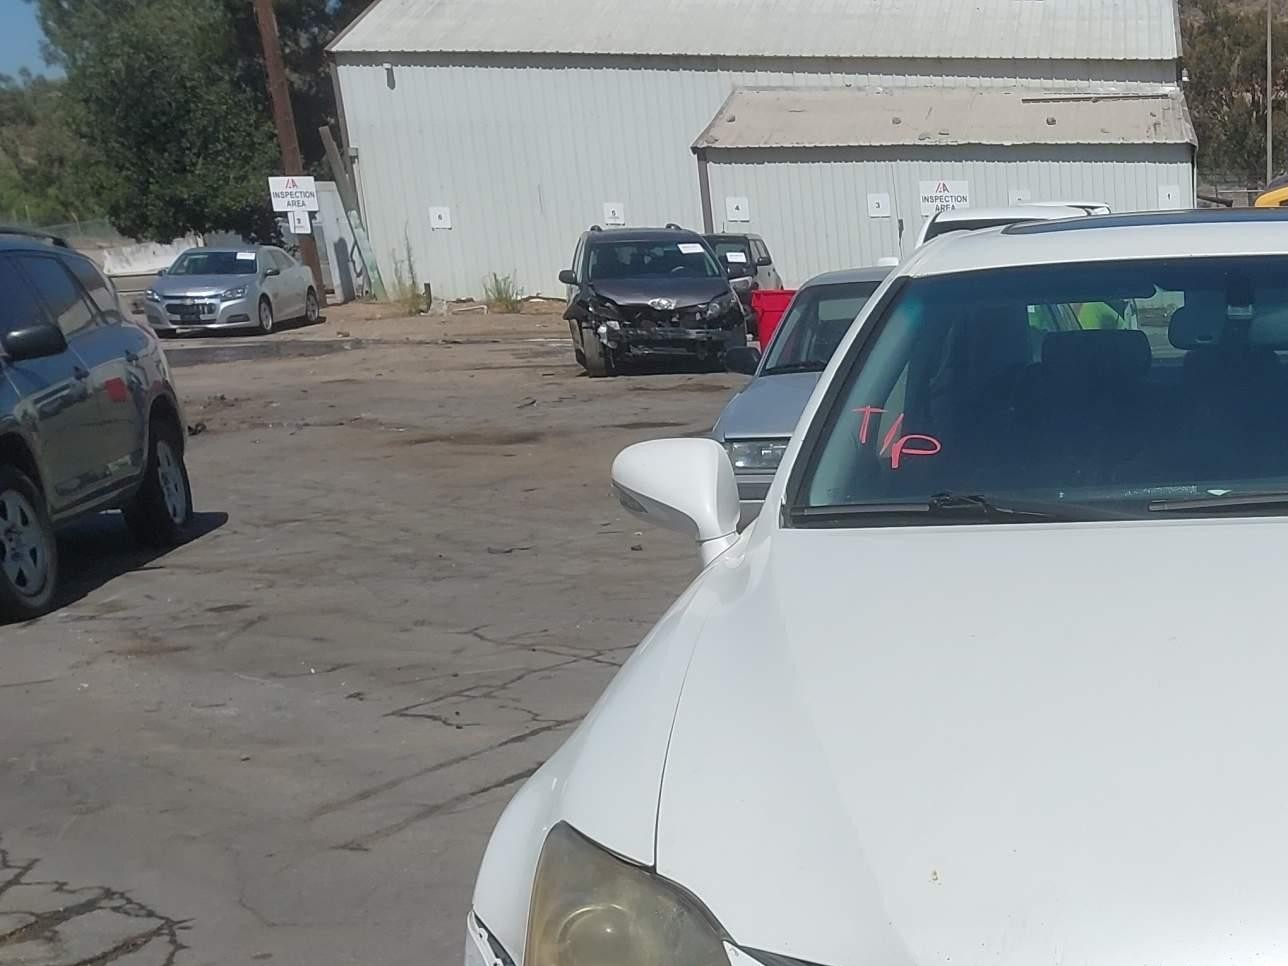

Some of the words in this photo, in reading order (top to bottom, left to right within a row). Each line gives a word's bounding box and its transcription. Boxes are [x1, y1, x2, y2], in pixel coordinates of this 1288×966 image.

[272, 191, 315, 199] INSPECTION
[921, 195, 968, 203] INSPECTION
[286, 199, 306, 207] AREA
